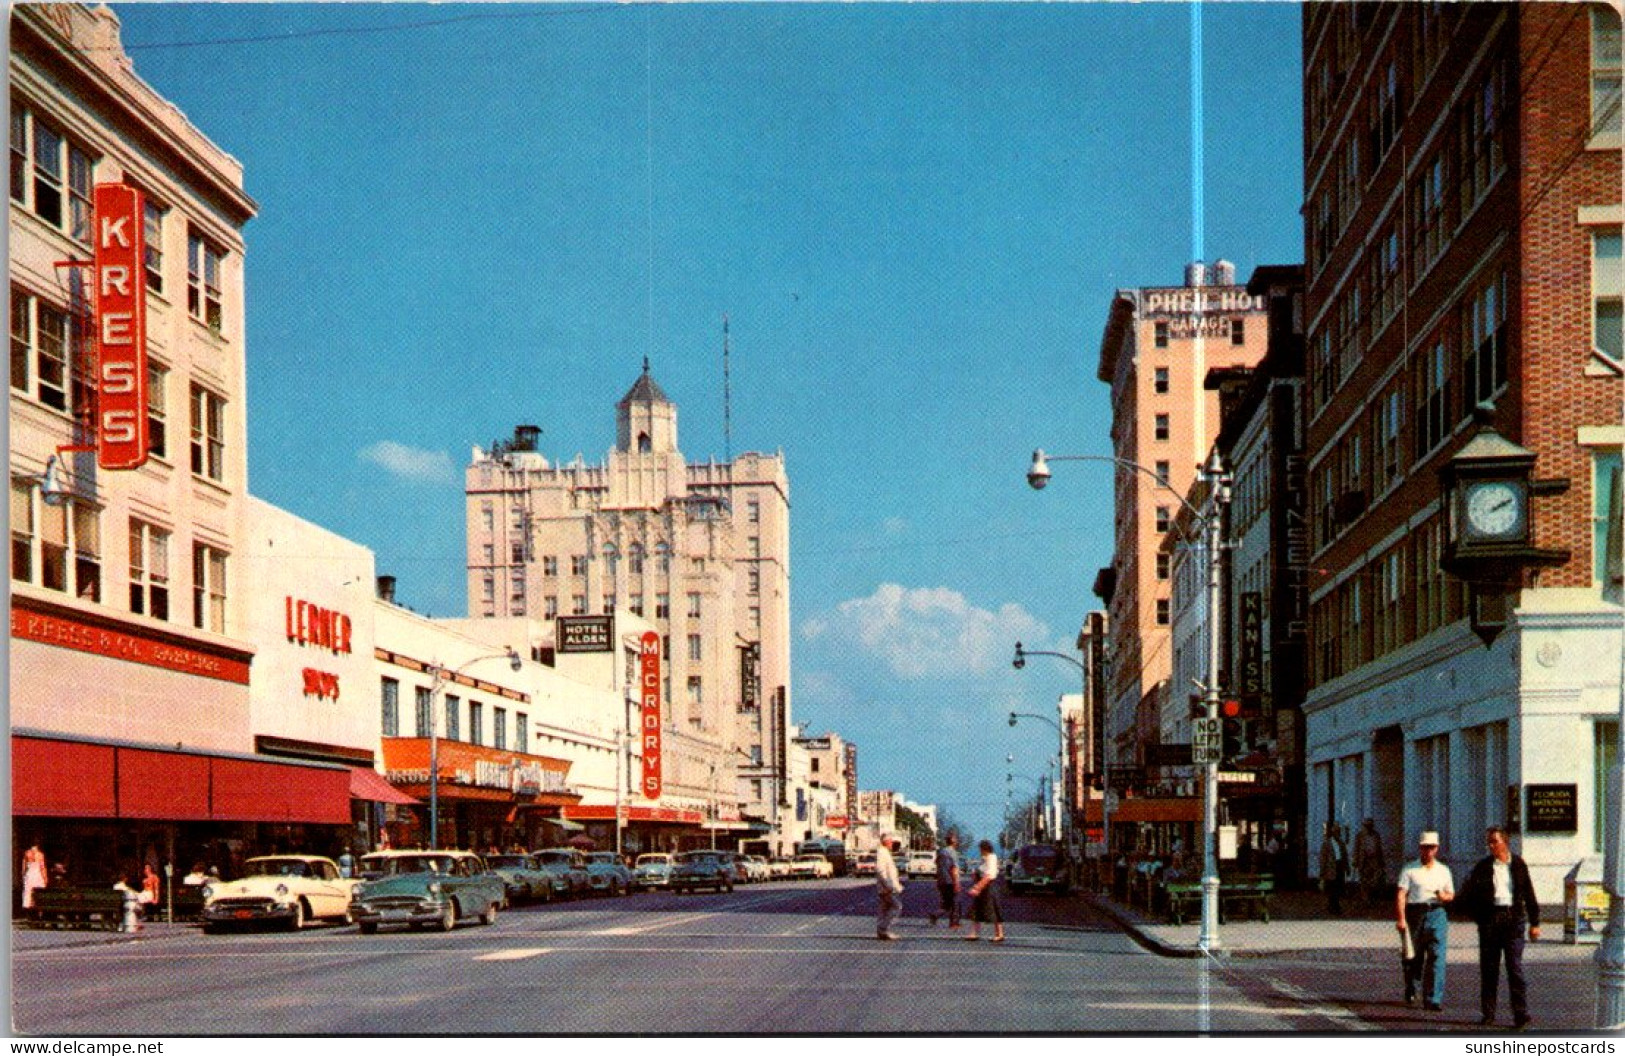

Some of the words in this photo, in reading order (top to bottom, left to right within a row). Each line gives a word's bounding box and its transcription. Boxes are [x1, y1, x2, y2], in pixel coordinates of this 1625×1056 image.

[101, 215, 136, 443] KRESS
[1170, 317, 1228, 331] GARAGE
[286, 595, 352, 654] LERNER
[565, 625, 607, 635] HOTEL
[565, 634, 607, 643] ALDEN
[1245, 595, 1259, 693] KANISS
[1197, 720, 1218, 732] NO
[1194, 733, 1221, 746] LEFT
[1194, 747, 1220, 760] TURN
[1533, 791, 1571, 799] FLORIDA
[1531, 799, 1572, 807] NATIONAL
[1538, 807, 1565, 816] BANK
